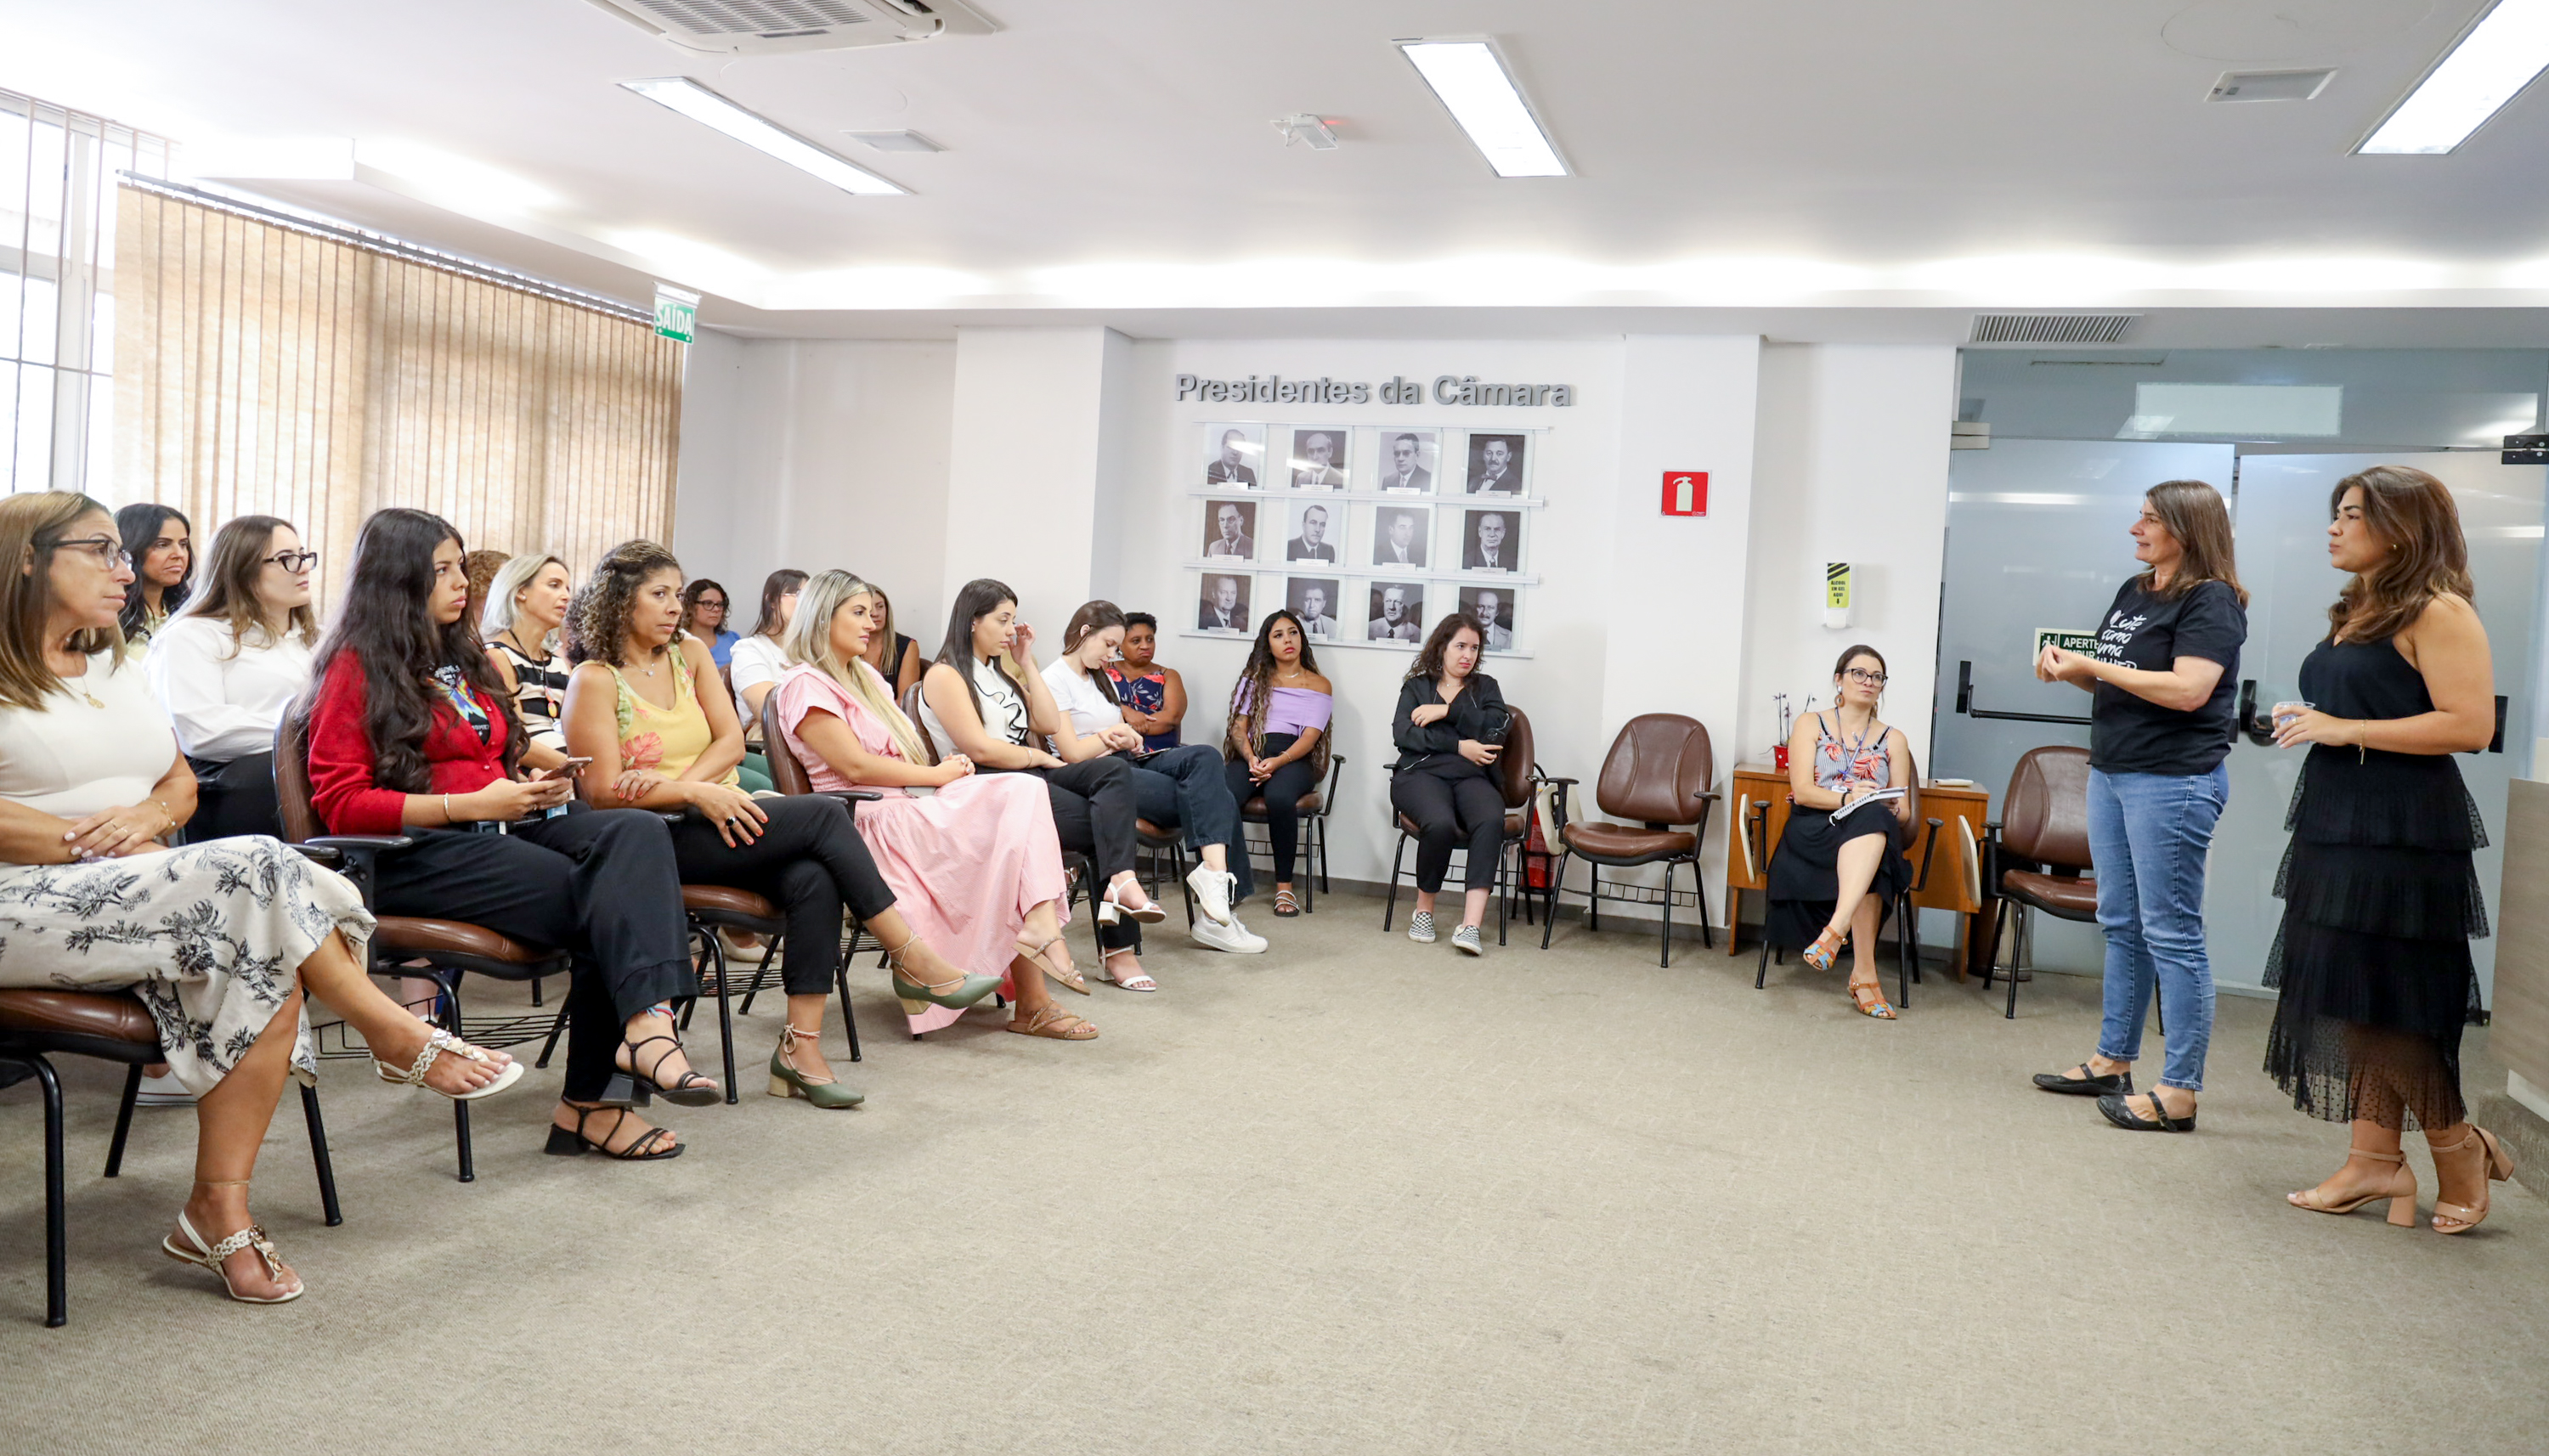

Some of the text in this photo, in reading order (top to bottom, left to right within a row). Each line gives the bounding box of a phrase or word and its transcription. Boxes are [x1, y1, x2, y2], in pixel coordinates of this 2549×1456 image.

[656, 303, 692, 336] SAÍDA
[1176, 374, 1571, 407] Presidentes da Câmara
[2101, 629, 2133, 644] como
[2097, 642, 2124, 657] uma
